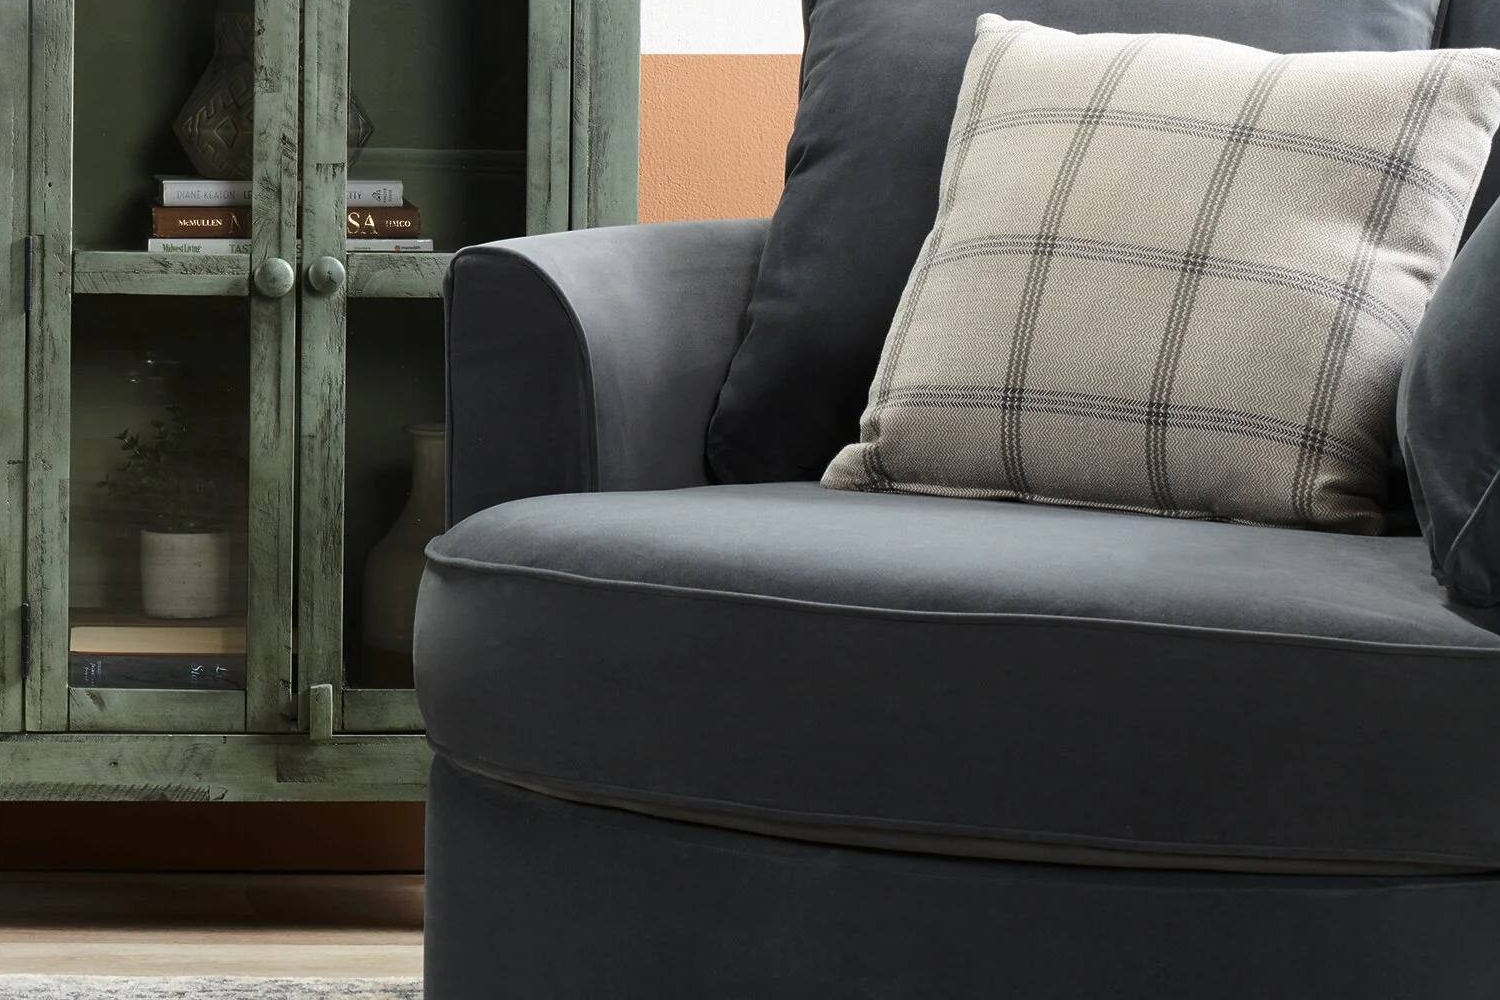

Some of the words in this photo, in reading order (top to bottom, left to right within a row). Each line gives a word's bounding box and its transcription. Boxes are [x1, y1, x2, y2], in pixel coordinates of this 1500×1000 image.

[176, 190, 201, 200] DIANE
[204, 190, 235, 200] KEATON
[178, 218, 223, 226] McMULLEN
